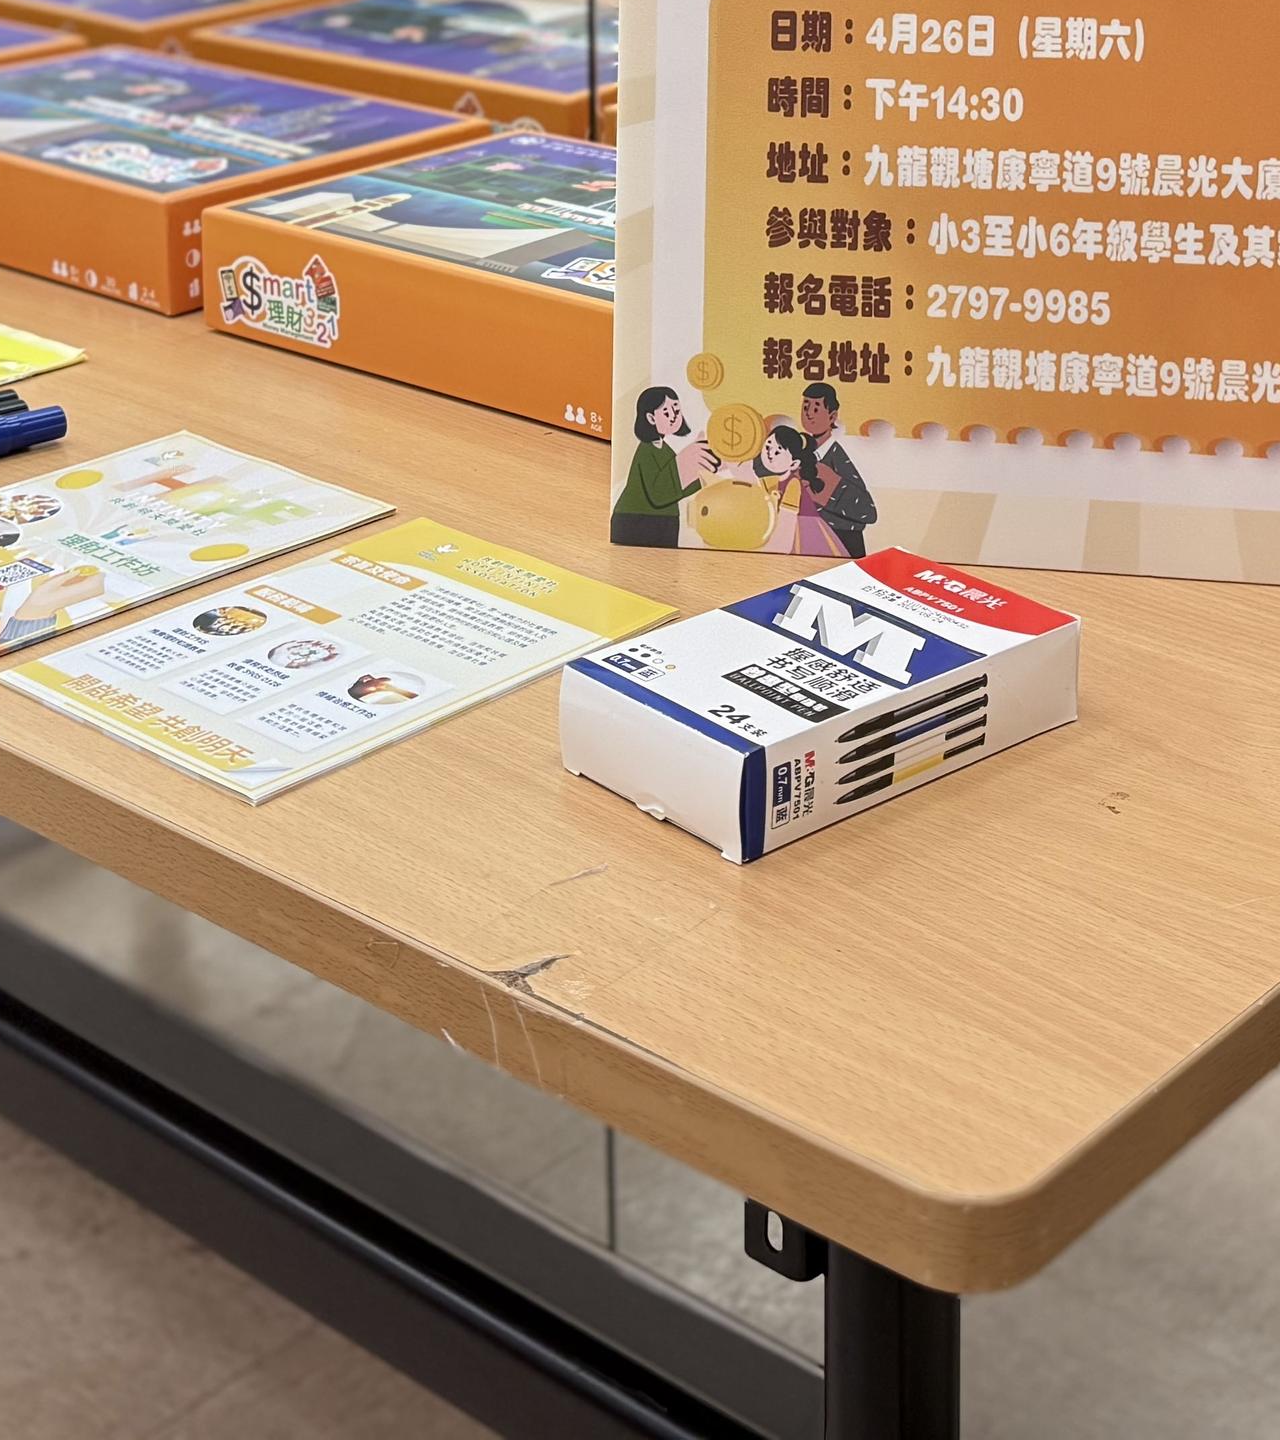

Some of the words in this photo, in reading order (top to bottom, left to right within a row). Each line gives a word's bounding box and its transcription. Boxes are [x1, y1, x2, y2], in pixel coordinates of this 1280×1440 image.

[865, 77, 1026, 124] 下午14:30
[926, 283, 1112, 327] 2797-9985
[51, 532, 164, 578] 理財工作坊
[765, 656, 860, 702] 书写顺滑
[781, 647, 882, 694] 握感舒适
[729, 672, 791, 705] BALLPOINT
[790, 700, 817, 718] PEN
[145, 713, 259, 765] 共創明天
